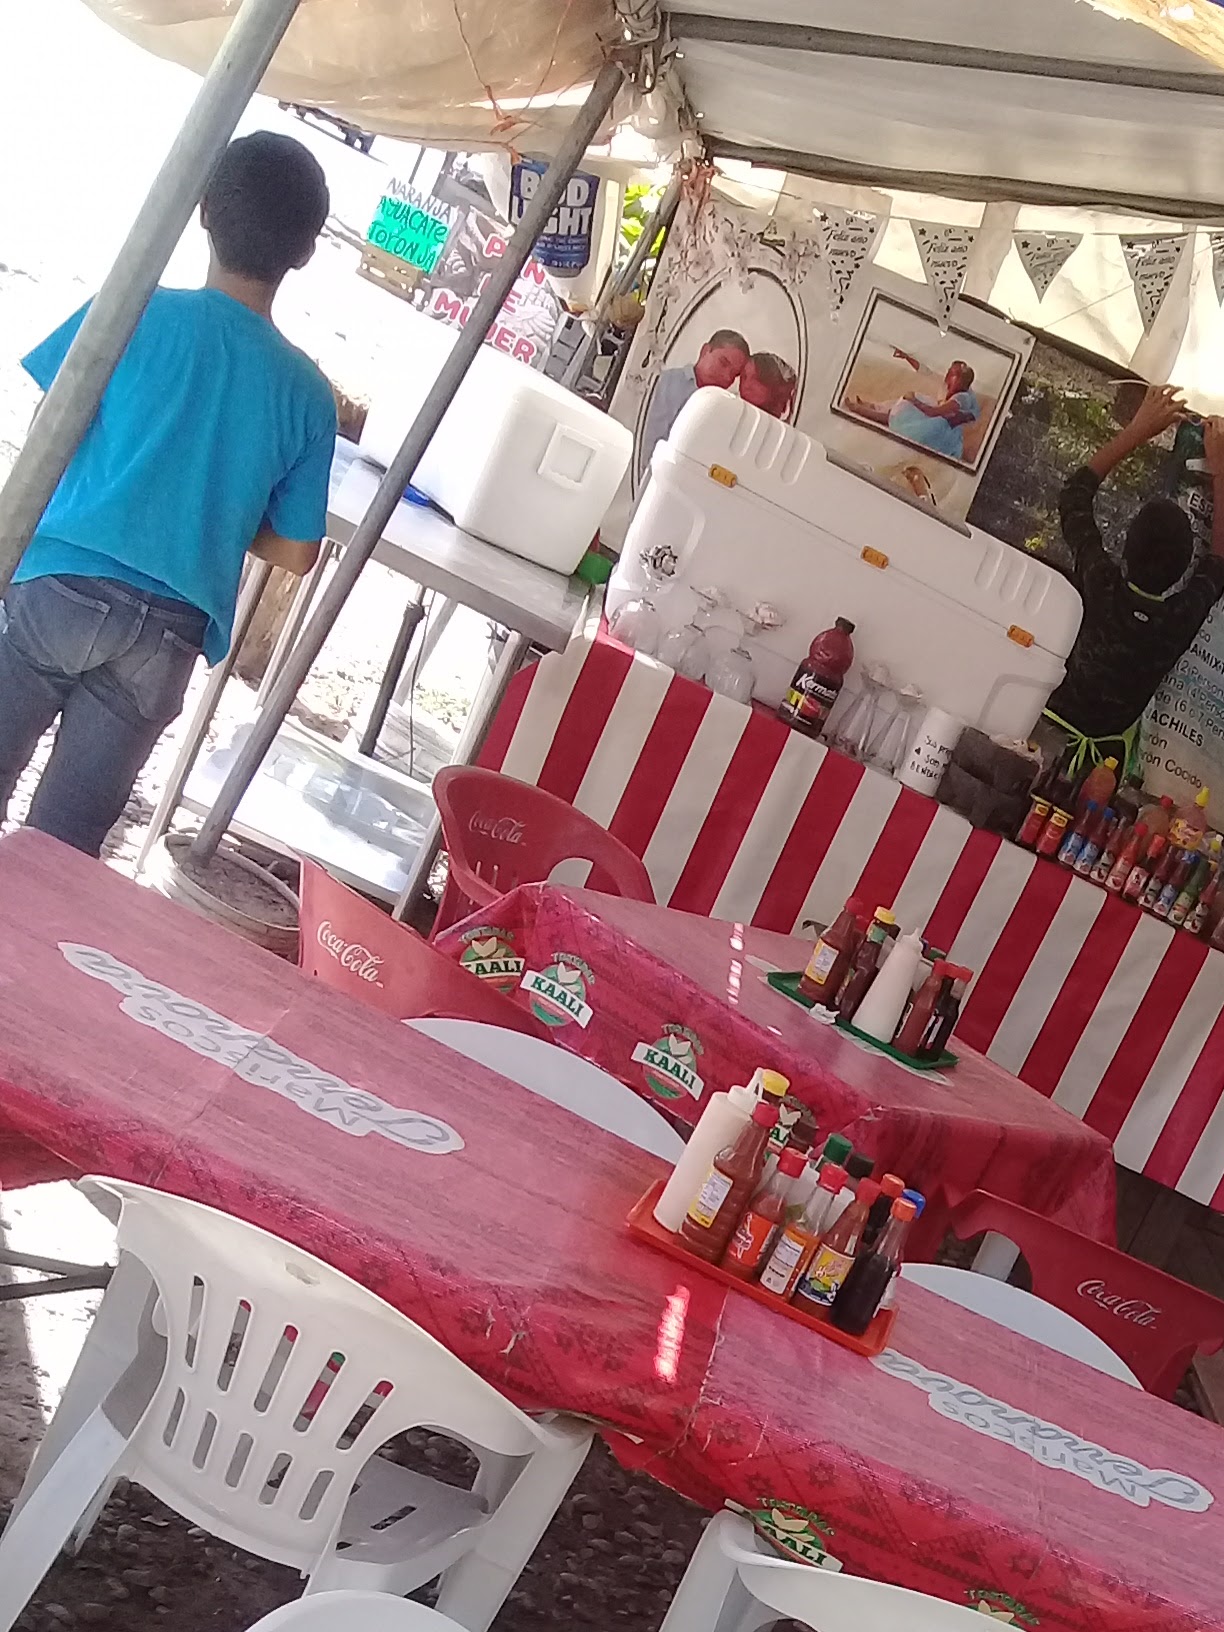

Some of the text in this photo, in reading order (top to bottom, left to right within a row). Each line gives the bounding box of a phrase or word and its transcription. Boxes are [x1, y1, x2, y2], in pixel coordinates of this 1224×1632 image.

[386, 177, 452, 225] NARANJA
[520, 168, 590, 207] BD
[511, 195, 593, 236] LHT
[485, 235, 546, 286] PN
[1149, 709, 1204, 747] ACHILES
[316, 920, 385, 990] Coca-Cola
[464, 960, 523, 976] AALI
[530, 975, 585, 1018] KAALI
[138, 1004, 360, 1127] Mariscos
[643, 1048, 697, 1090] KAALI
[1076, 1279, 1162, 1330] Coca-Cola
[941, 1398, 1140, 1501] Mariscos
